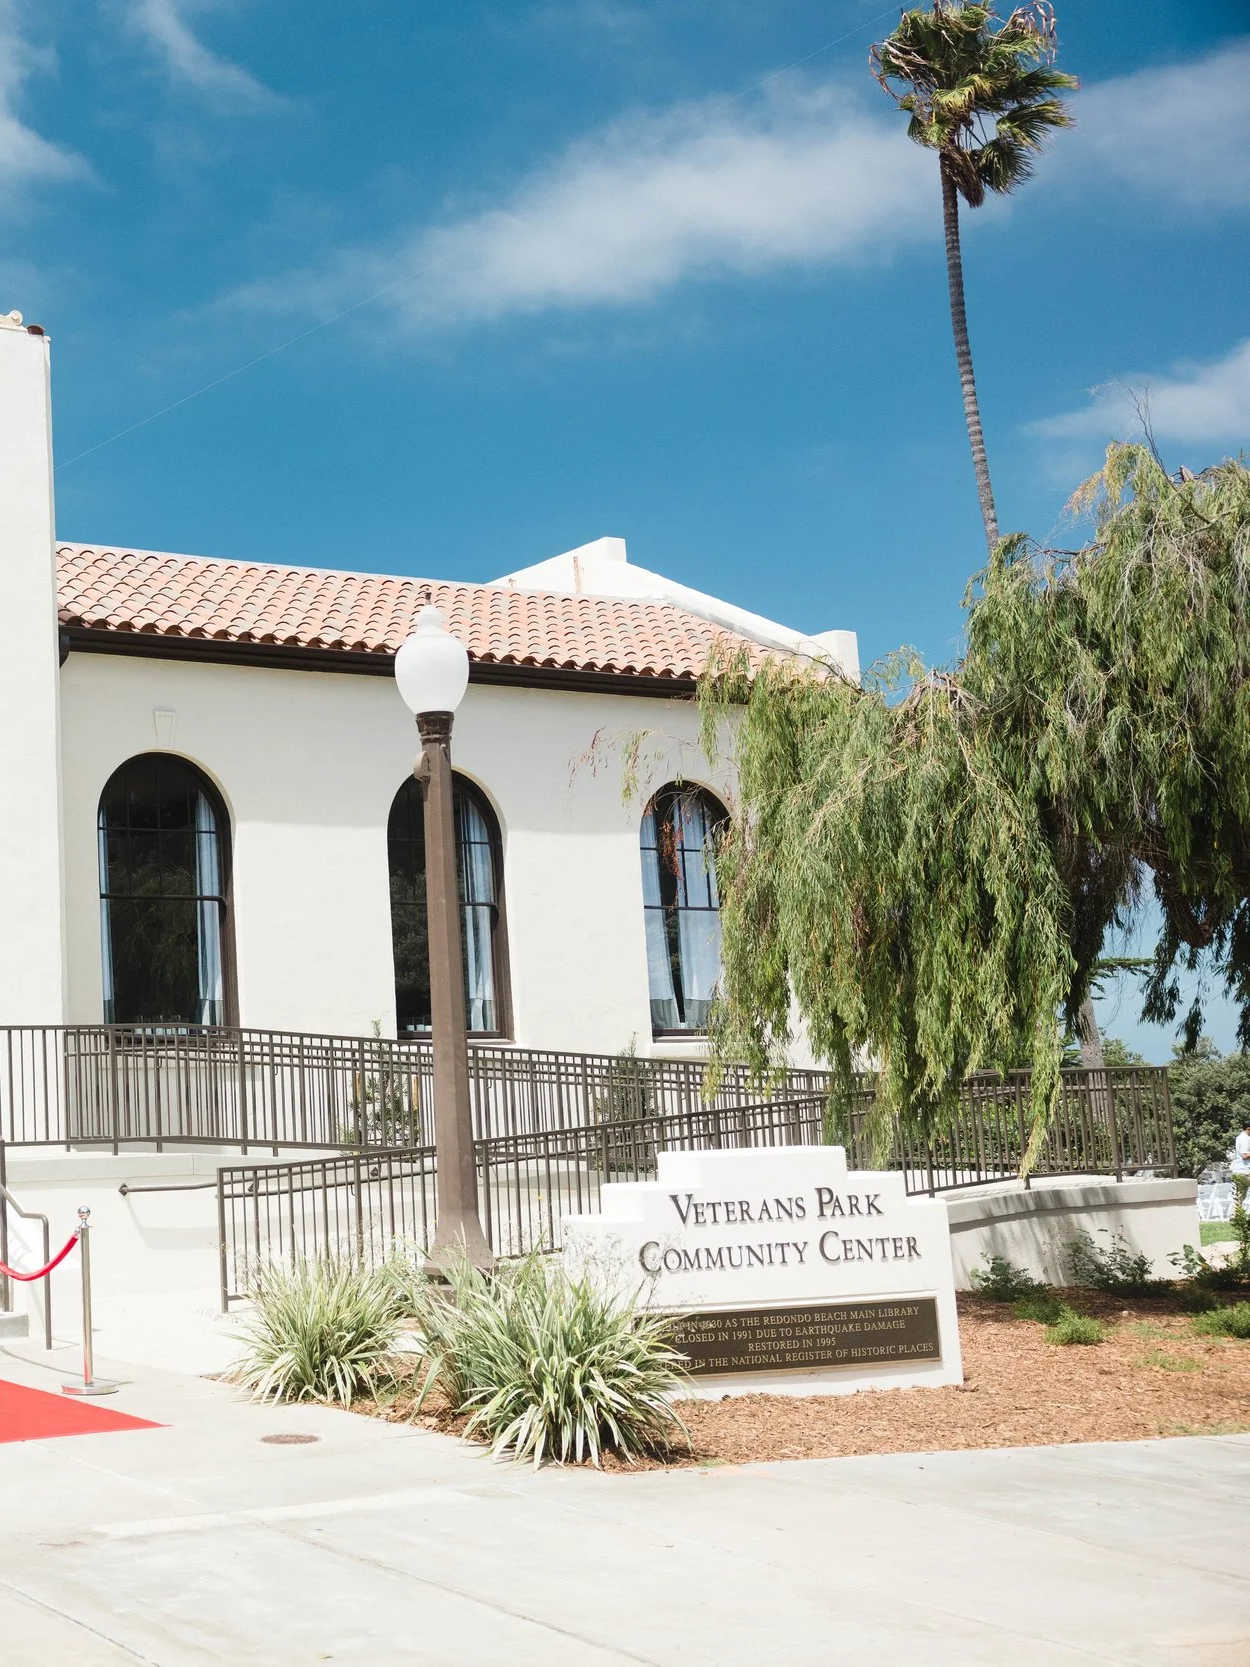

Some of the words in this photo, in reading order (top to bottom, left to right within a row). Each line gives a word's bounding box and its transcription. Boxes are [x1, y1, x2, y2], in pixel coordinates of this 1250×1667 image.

[668, 1193, 807, 1226] VETERANS
[814, 1187, 884, 1217] PARK
[638, 1240, 808, 1273] COMMUNITY
[818, 1230, 922, 1262] CENTER
[725, 1319, 738, 1328] AS
[740, 1317, 760, 1327] THE
[763, 1314, 811, 1325] REDONDO
[814, 1311, 847, 1322] BEACH
[850, 1309, 875, 1320] MAIN
[878, 1307, 919, 1318] LIBRARY
[675, 1333, 715, 1344] CLOSED
[718, 1332, 729, 1341] IN
[733, 1331, 752, 1340] 1991
[756, 1329, 776, 1339] DUE
[779, 1327, 793, 1337] TO
[795, 1323, 861, 1336] EARTHQUAKE
[864, 1320, 906, 1331] DAMAGE
[695, 1359, 705, 1368] IN
[709, 1357, 729, 1368] THE
[731, 1354, 782, 1366] NATIONAL
[785, 1350, 833, 1362] REGISTER
[835, 1349, 849, 1359] OF
[851, 1346, 896, 1358] HISTORIC
[898, 1342, 934, 1354] PLACES
[748, 1340, 799, 1352] RESTORED
[802, 1339, 813, 1348] IN
[817, 1338, 836, 1347] 1995
